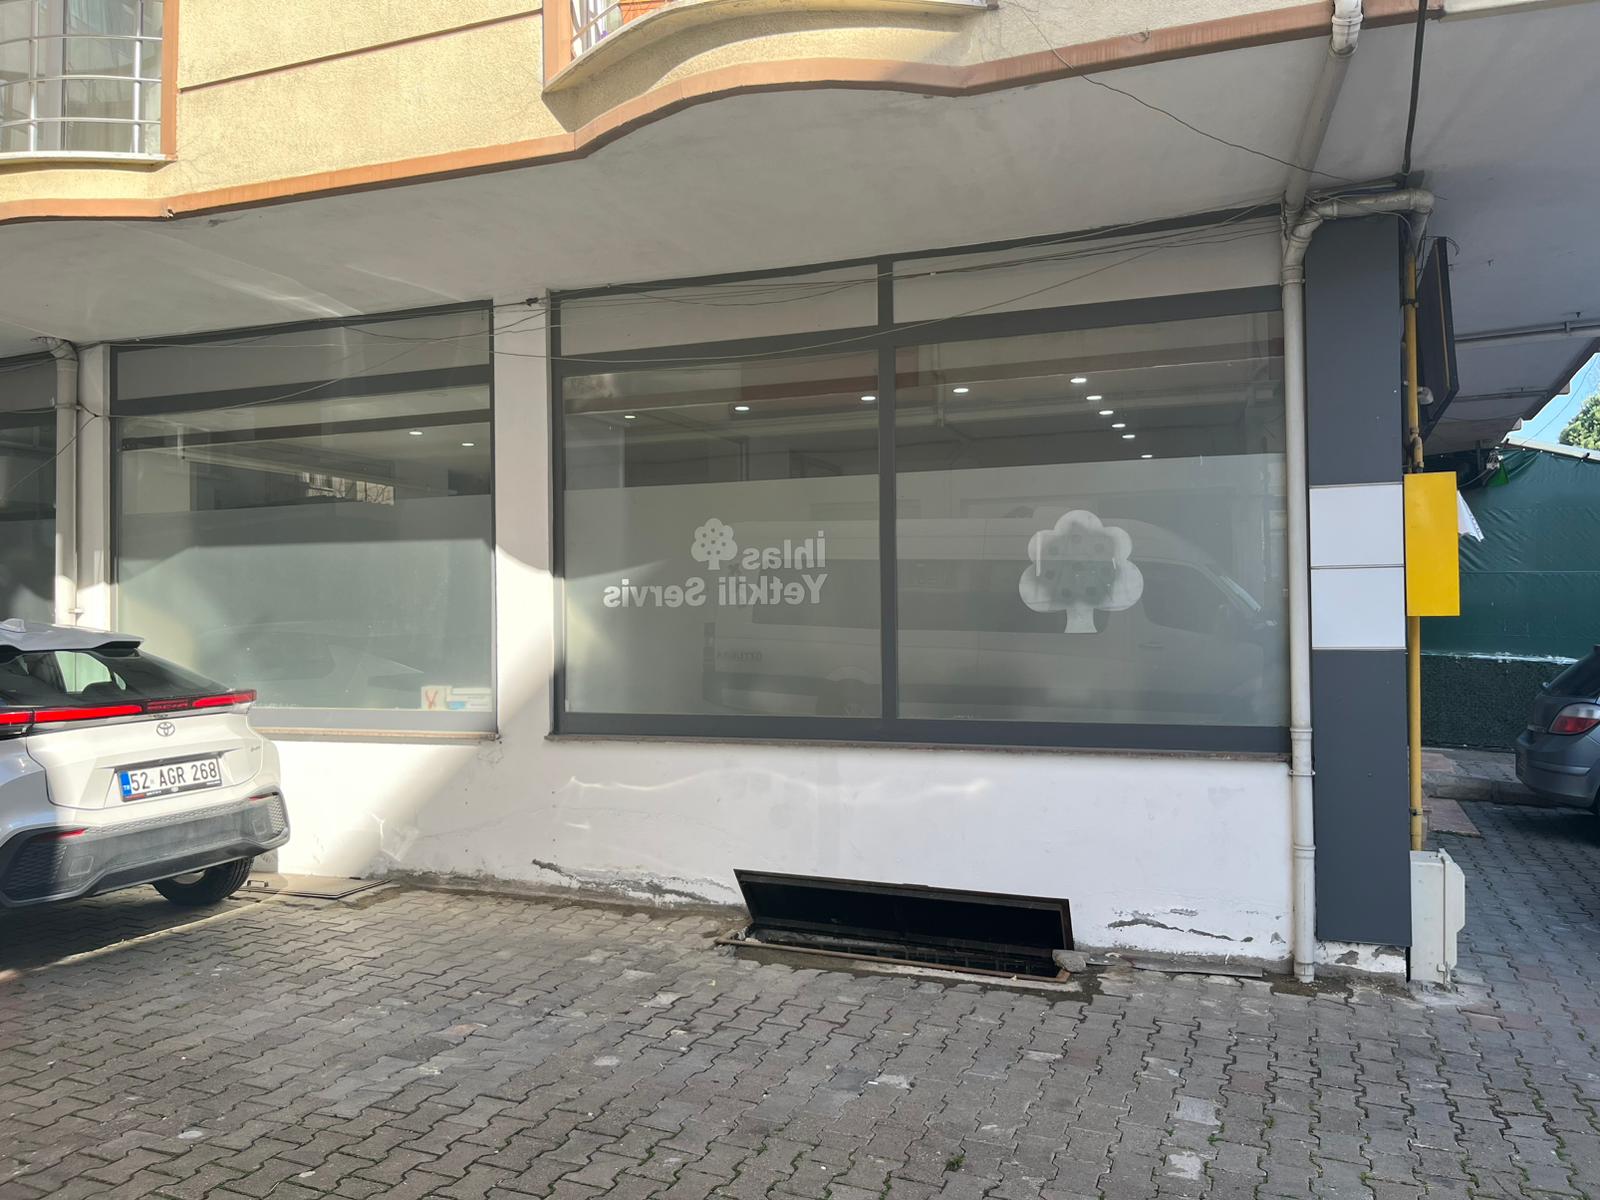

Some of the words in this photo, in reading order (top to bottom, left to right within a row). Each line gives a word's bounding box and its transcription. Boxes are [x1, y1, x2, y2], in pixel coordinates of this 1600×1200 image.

[130, 771, 151, 792] 52
[159, 766, 187, 787] AGR
[191, 761, 218, 782] 268
